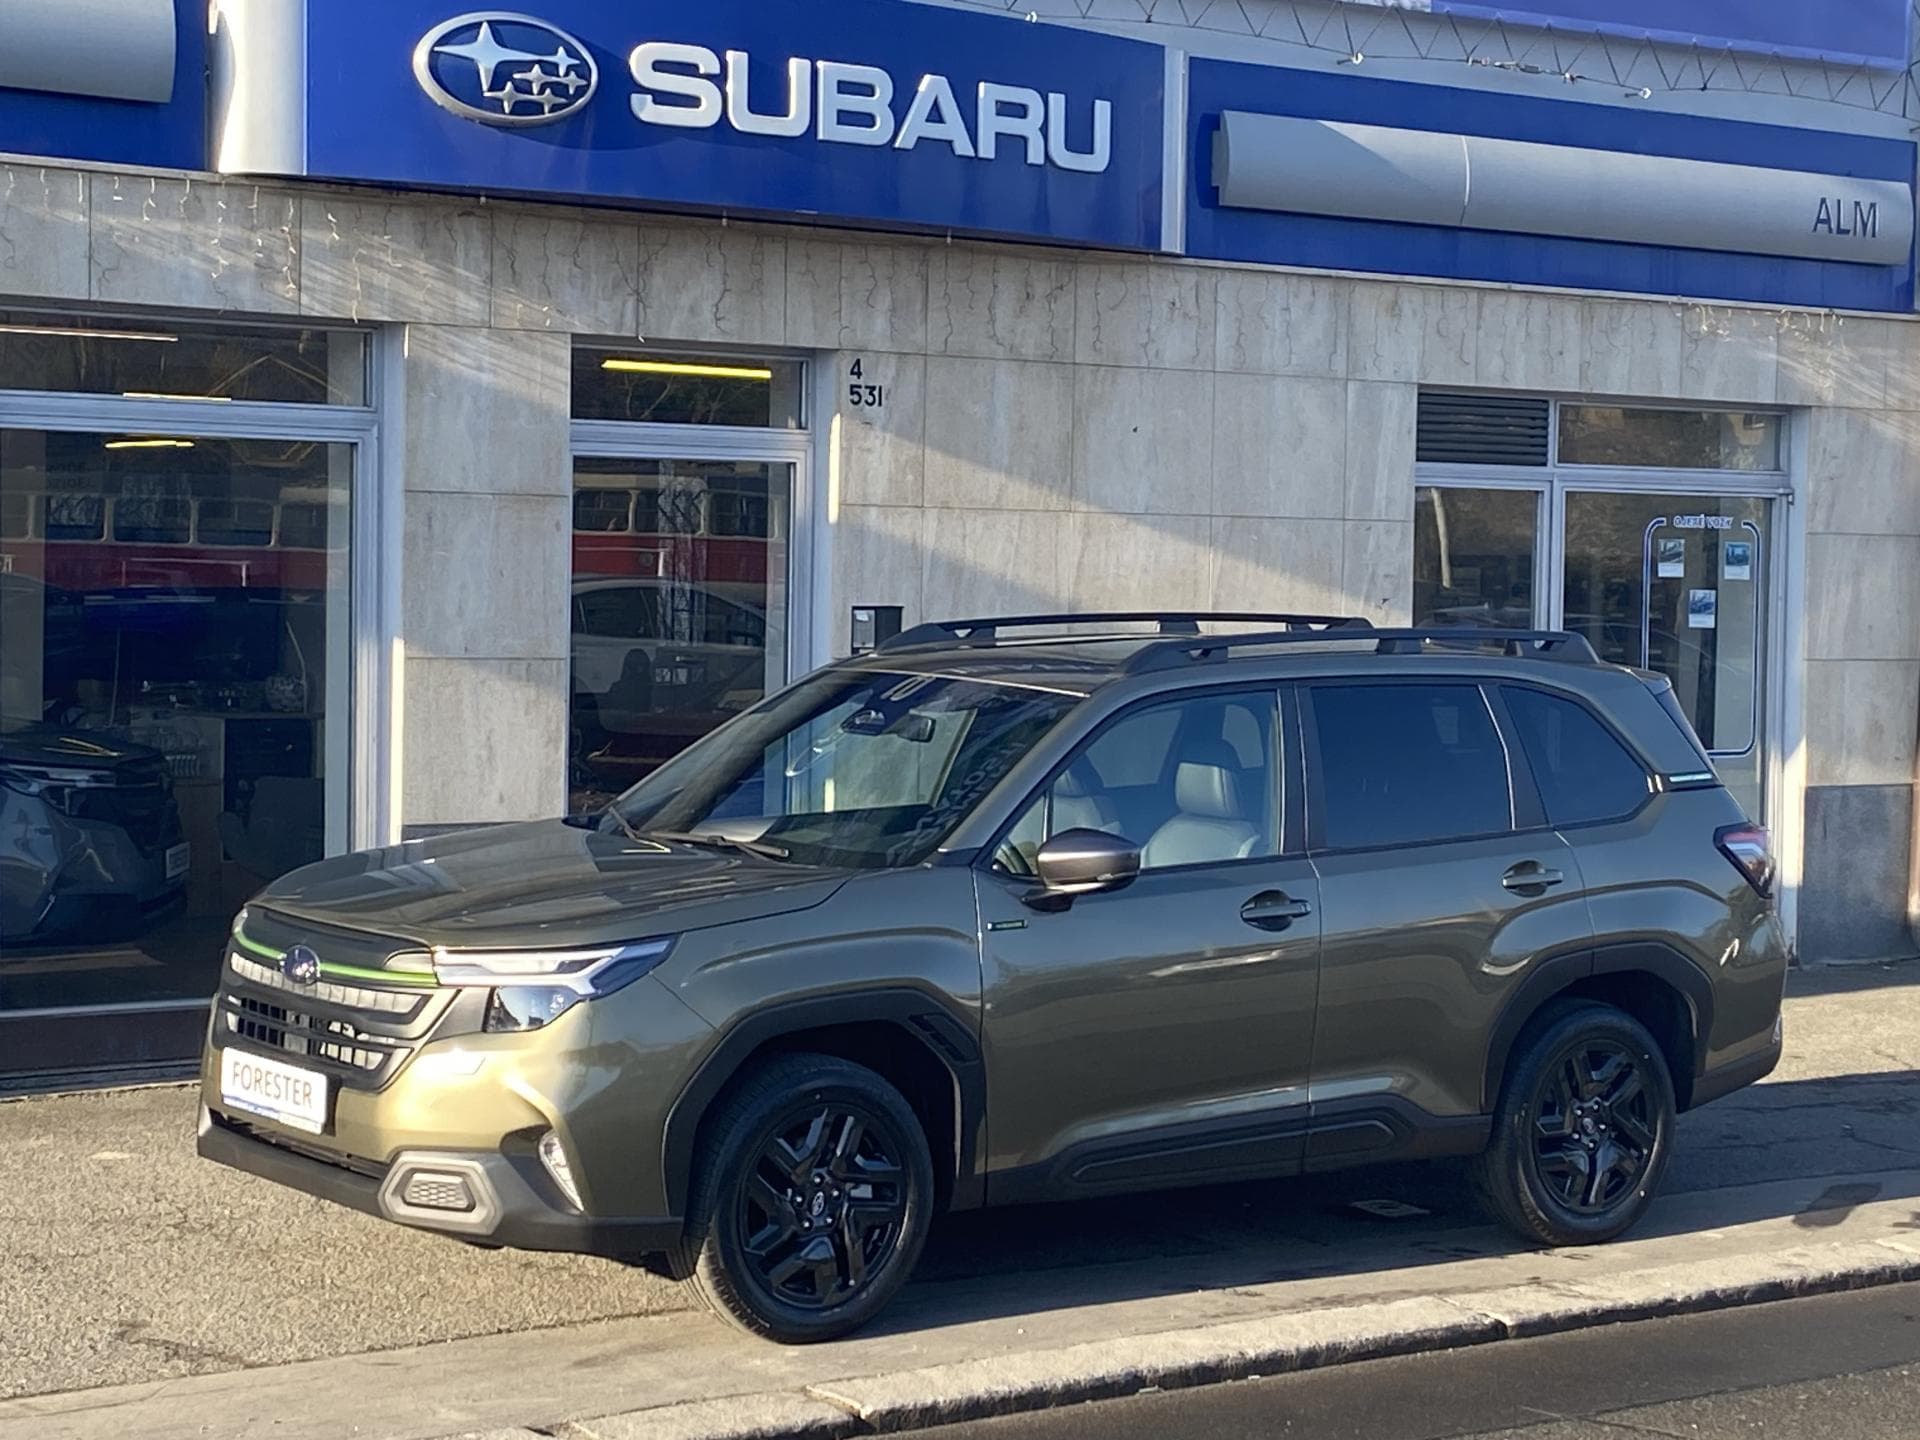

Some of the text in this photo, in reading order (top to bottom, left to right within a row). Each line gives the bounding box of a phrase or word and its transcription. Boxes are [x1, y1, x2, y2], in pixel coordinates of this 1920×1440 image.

[629, 42, 1111, 172] SUBARU
[1812, 197, 1877, 238] ALM
[850, 358, 862, 379] 4
[850, 384, 882, 407] 531
[232, 1061, 312, 1109] FORESTER
